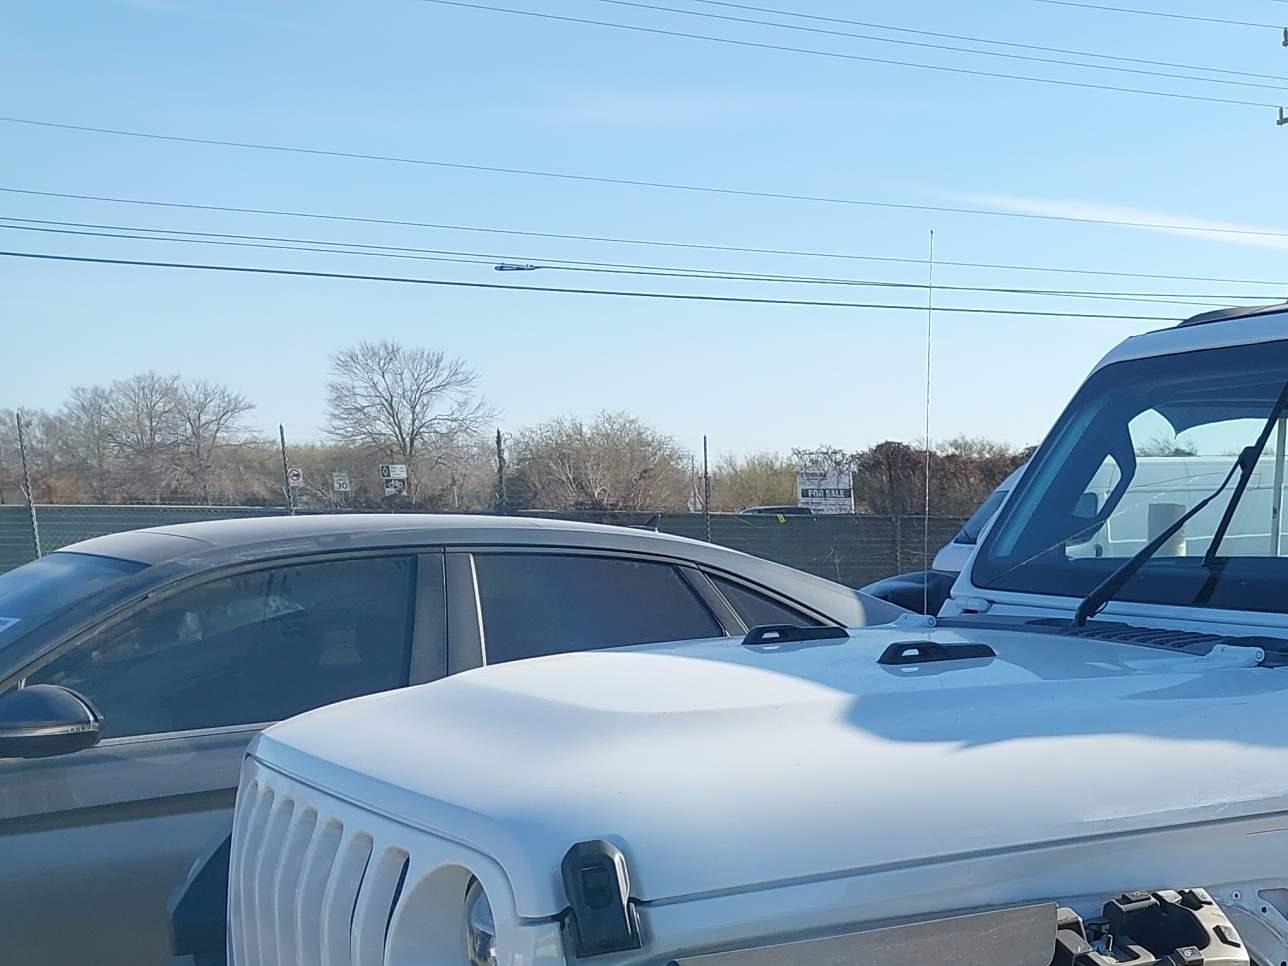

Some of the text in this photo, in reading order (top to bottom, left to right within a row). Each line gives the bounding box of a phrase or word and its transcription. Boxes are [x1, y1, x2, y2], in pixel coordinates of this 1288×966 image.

[336, 482, 348, 490] 30
[808, 489, 846, 498] FOR SALE
